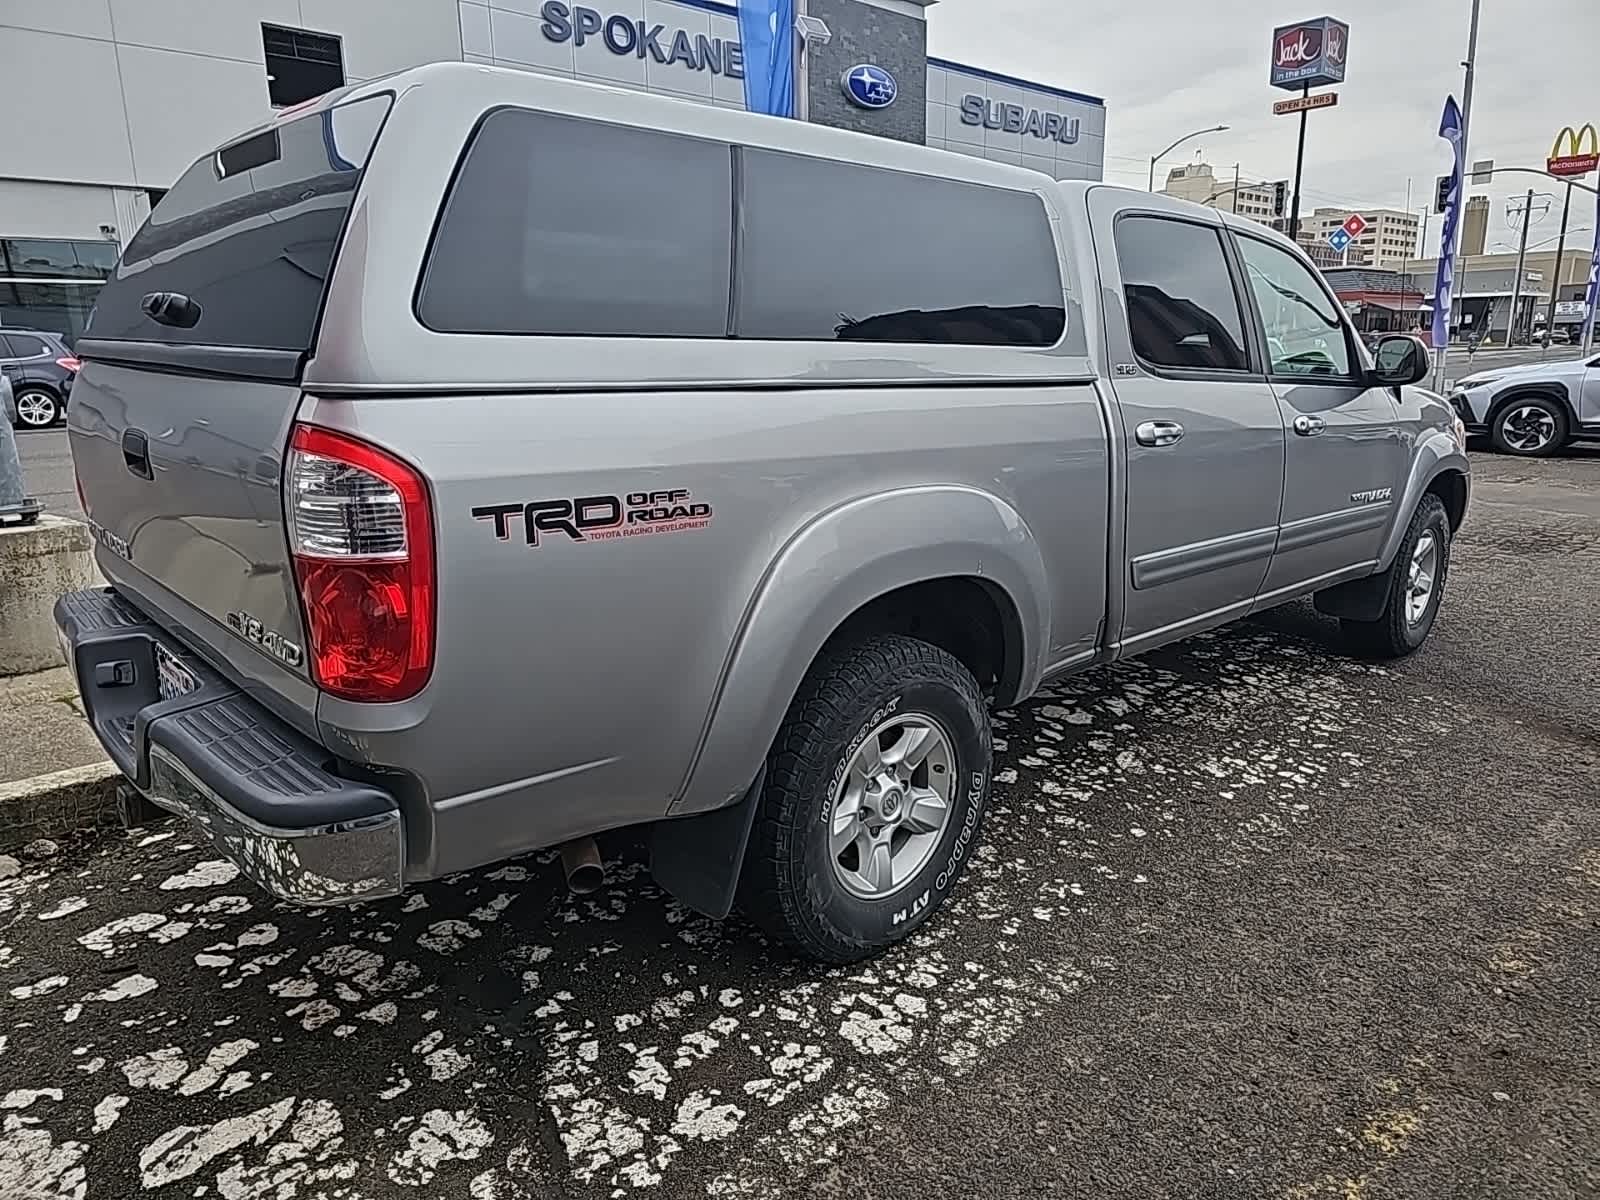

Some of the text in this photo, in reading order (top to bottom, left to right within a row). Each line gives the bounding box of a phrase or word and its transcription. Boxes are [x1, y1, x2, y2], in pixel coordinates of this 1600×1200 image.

[540, 1, 745, 79] SPOKANE
[1276, 31, 1320, 65] Jack
[1276, 72, 1284, 80] in
[1301, 67, 1318, 76] box
[961, 94, 1080, 144] SUBARU
[1276, 96, 1330, 111] OPEN 24 HRS
[472, 489, 690, 546] TRD OFF
[590, 520, 709, 540] TOYOTA RACING DEVELOPMENT
[627, 504, 712, 524] ROAD
[935, 771, 984, 890] Dynapro
